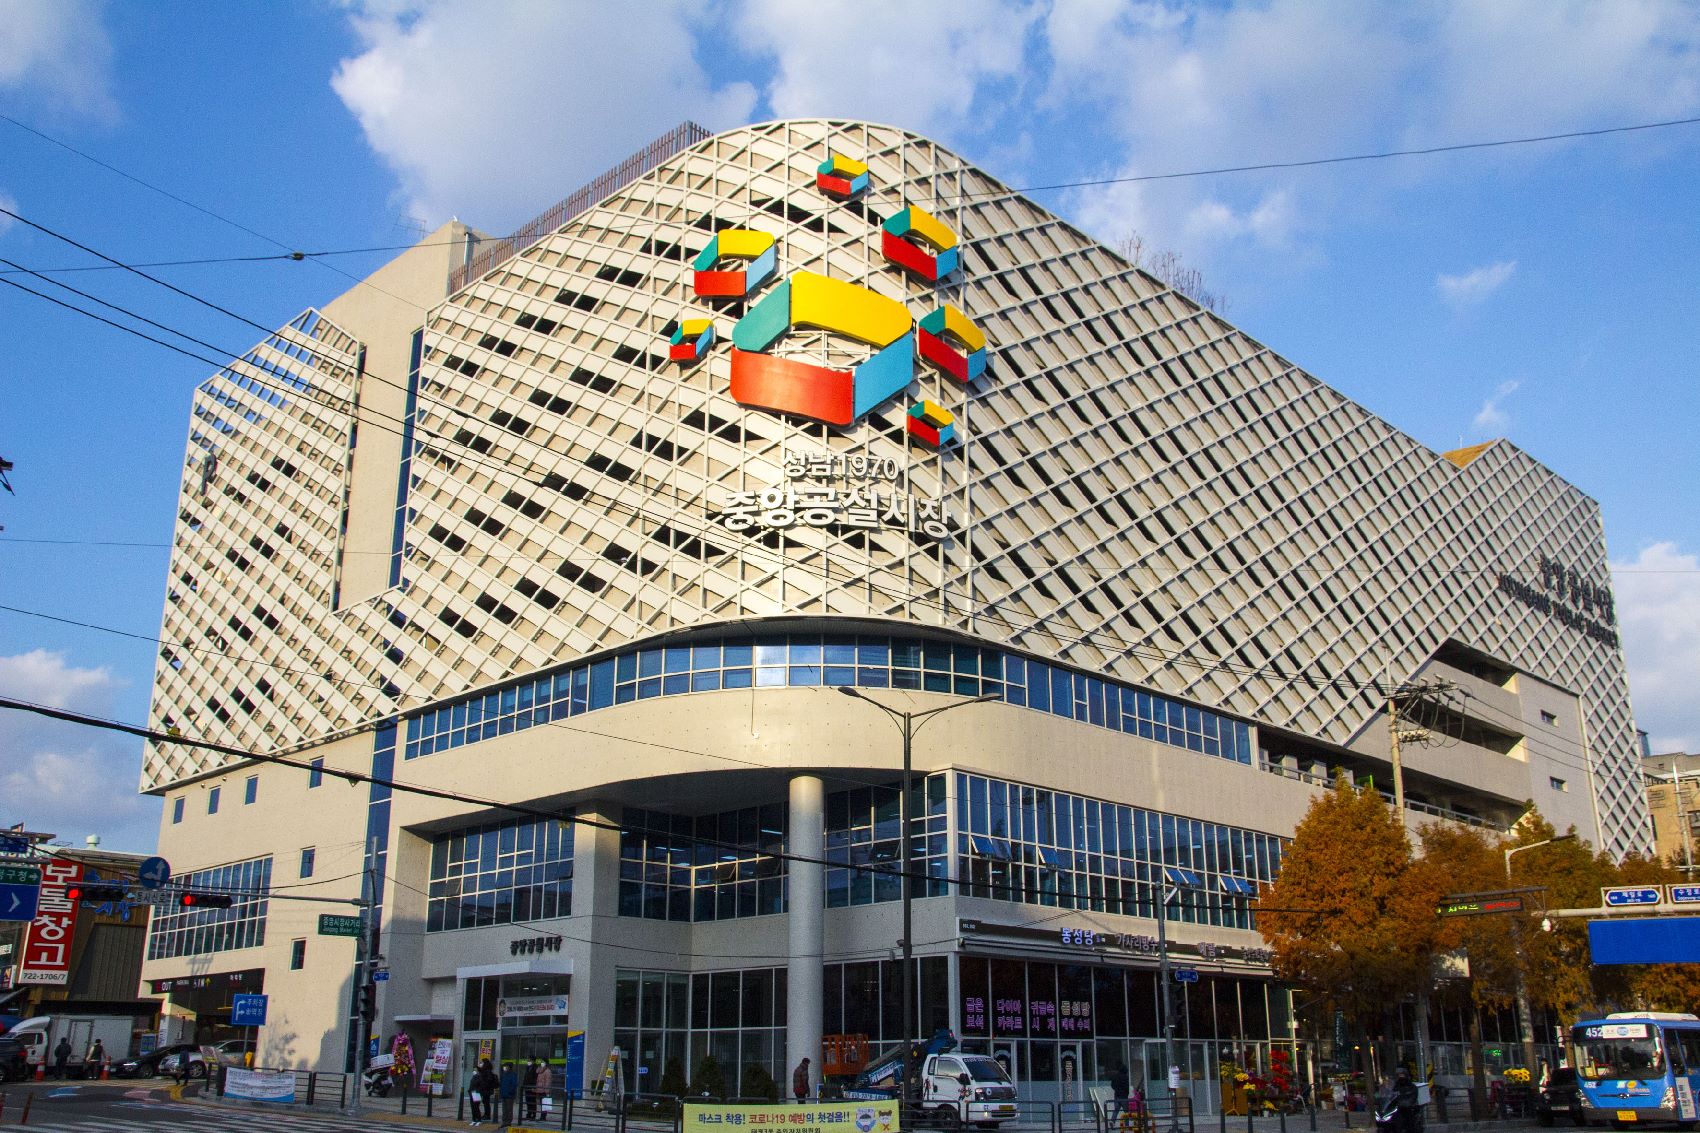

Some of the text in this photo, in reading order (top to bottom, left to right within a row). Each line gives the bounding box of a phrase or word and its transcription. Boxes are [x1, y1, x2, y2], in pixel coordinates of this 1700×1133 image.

[721, 487, 953, 540] 중앙공설시장
[23, 972, 66, 982] 722-1706/7
[1585, 1028, 1603, 1038] 452
[698, 1111, 850, 1124] 마스크 착용! 코로나19 예방의 첫걸음!!
